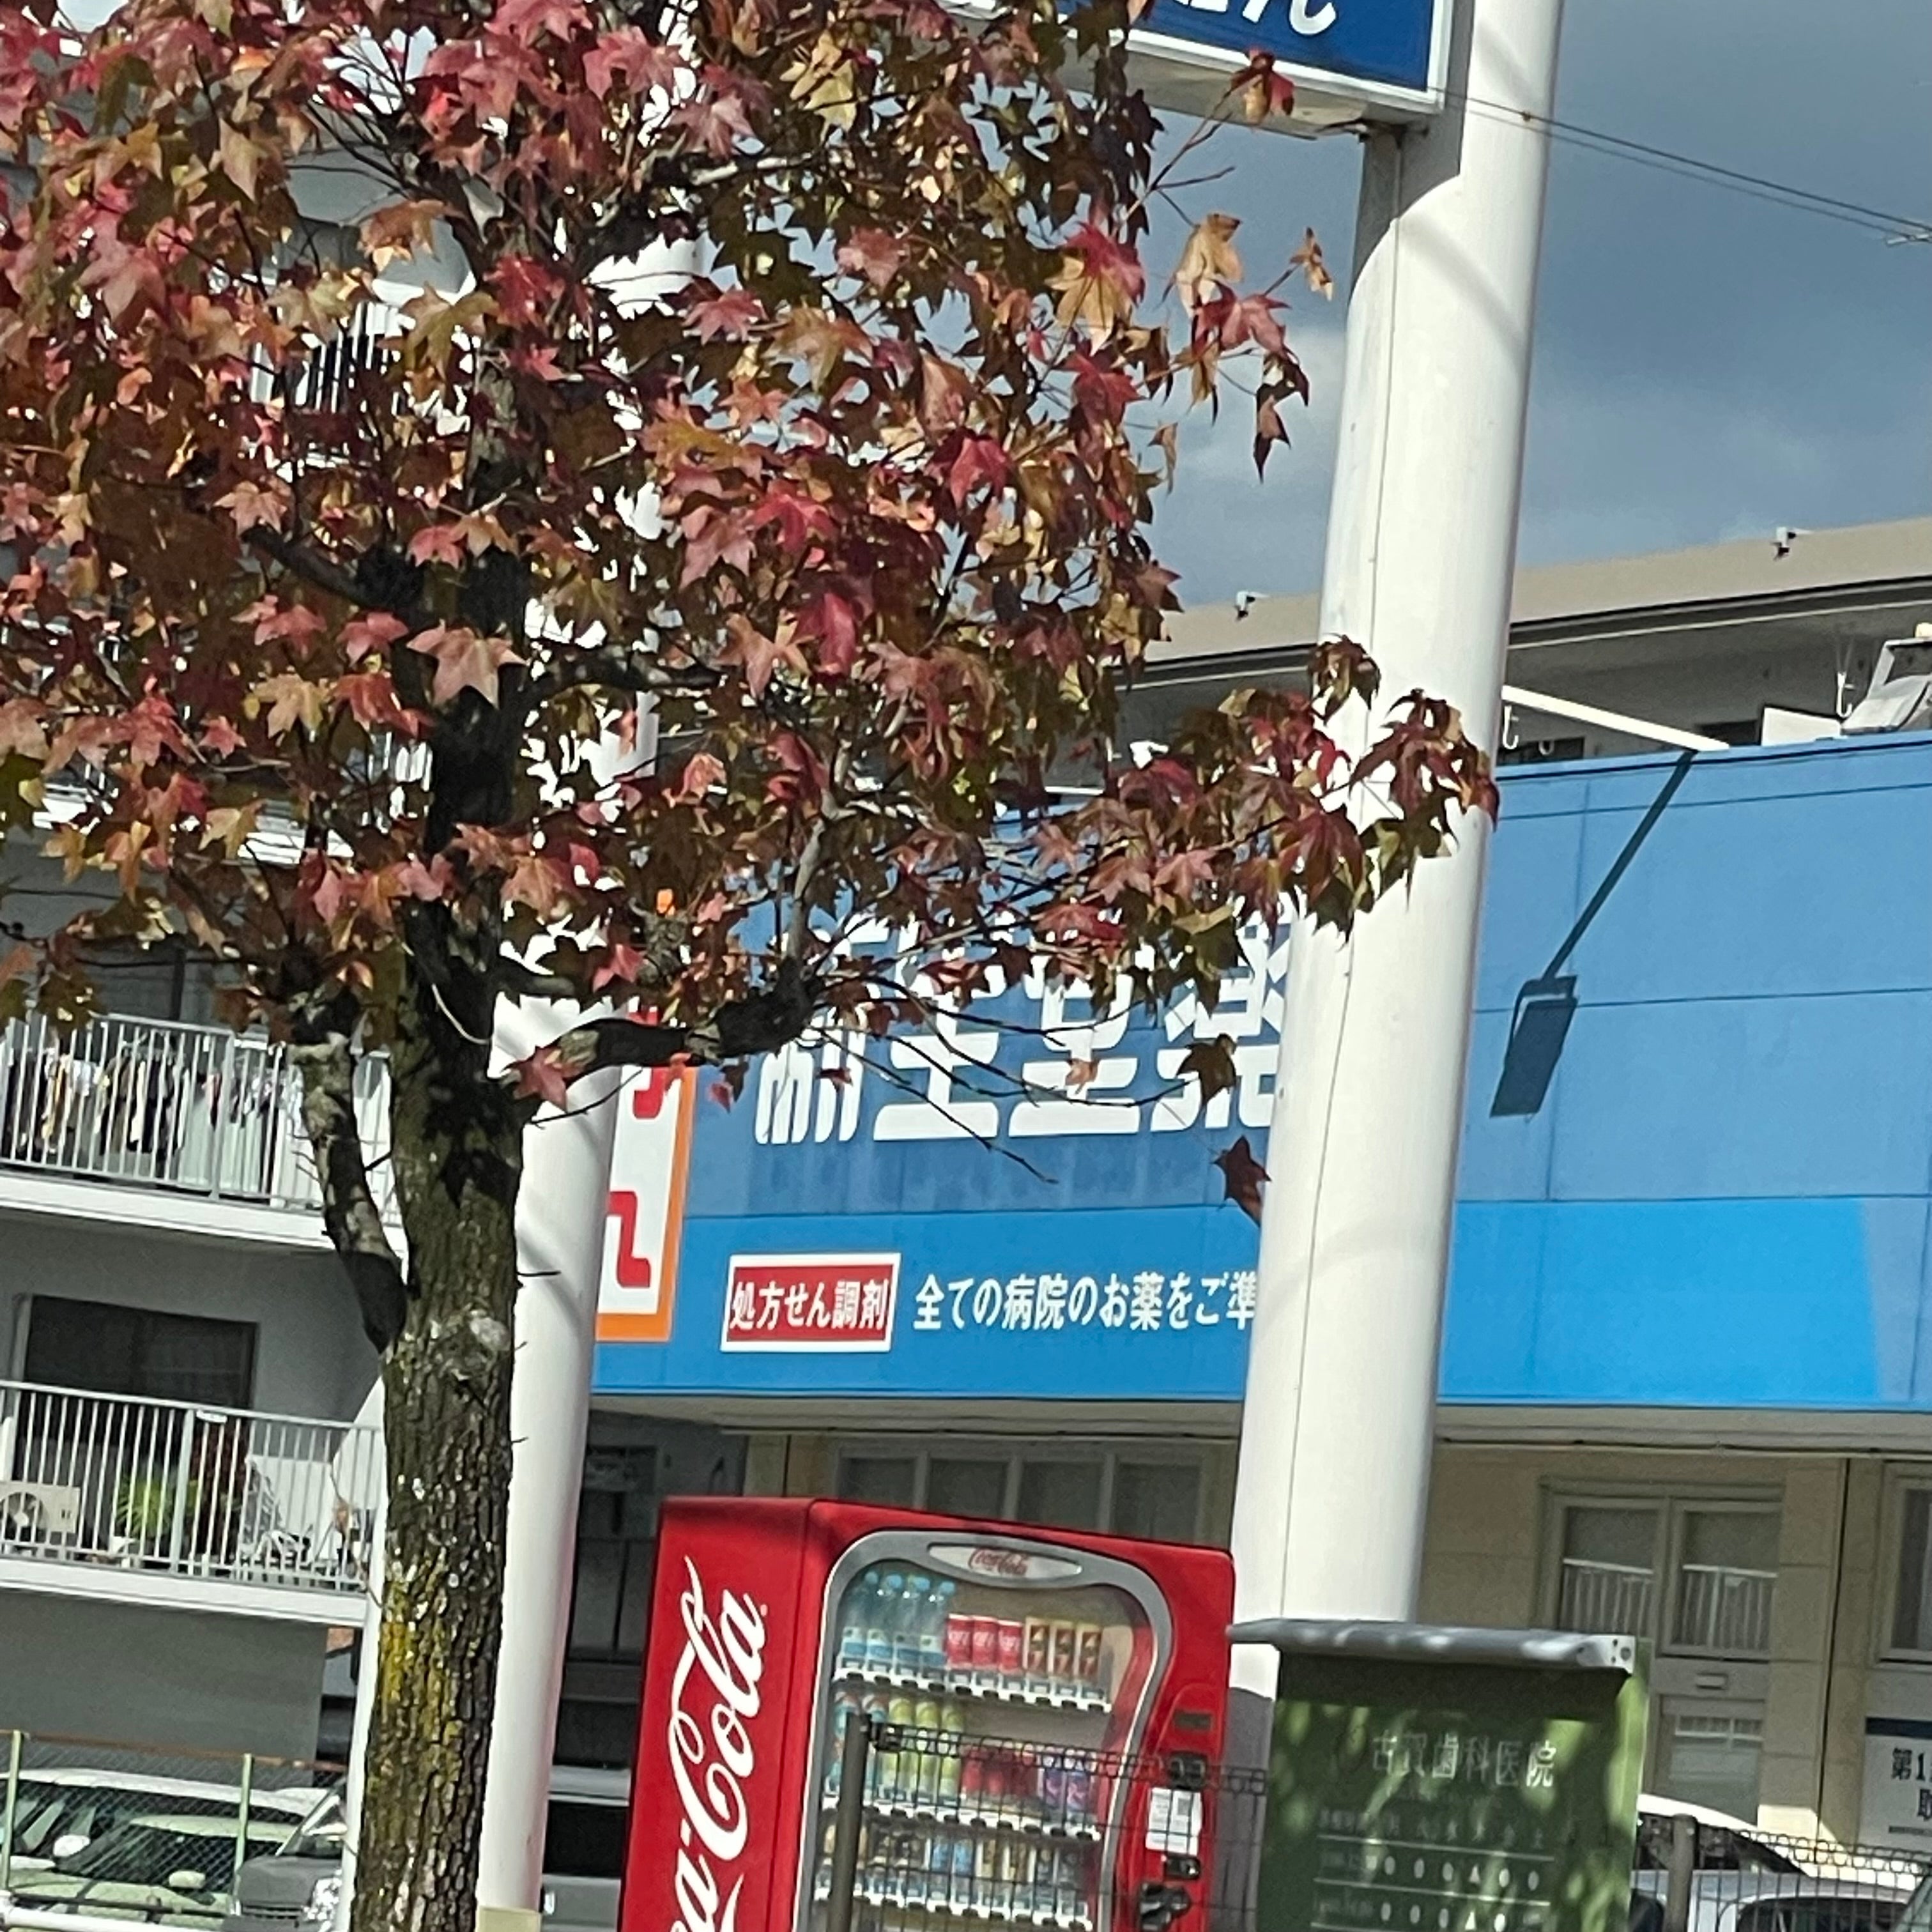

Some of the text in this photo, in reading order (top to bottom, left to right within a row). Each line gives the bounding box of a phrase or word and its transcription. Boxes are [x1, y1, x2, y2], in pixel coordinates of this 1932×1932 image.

[730, 1279, 889, 1330] 処方せん調剤
[913, 1271, 1257, 1330] 全ての病院のお薬をご準
